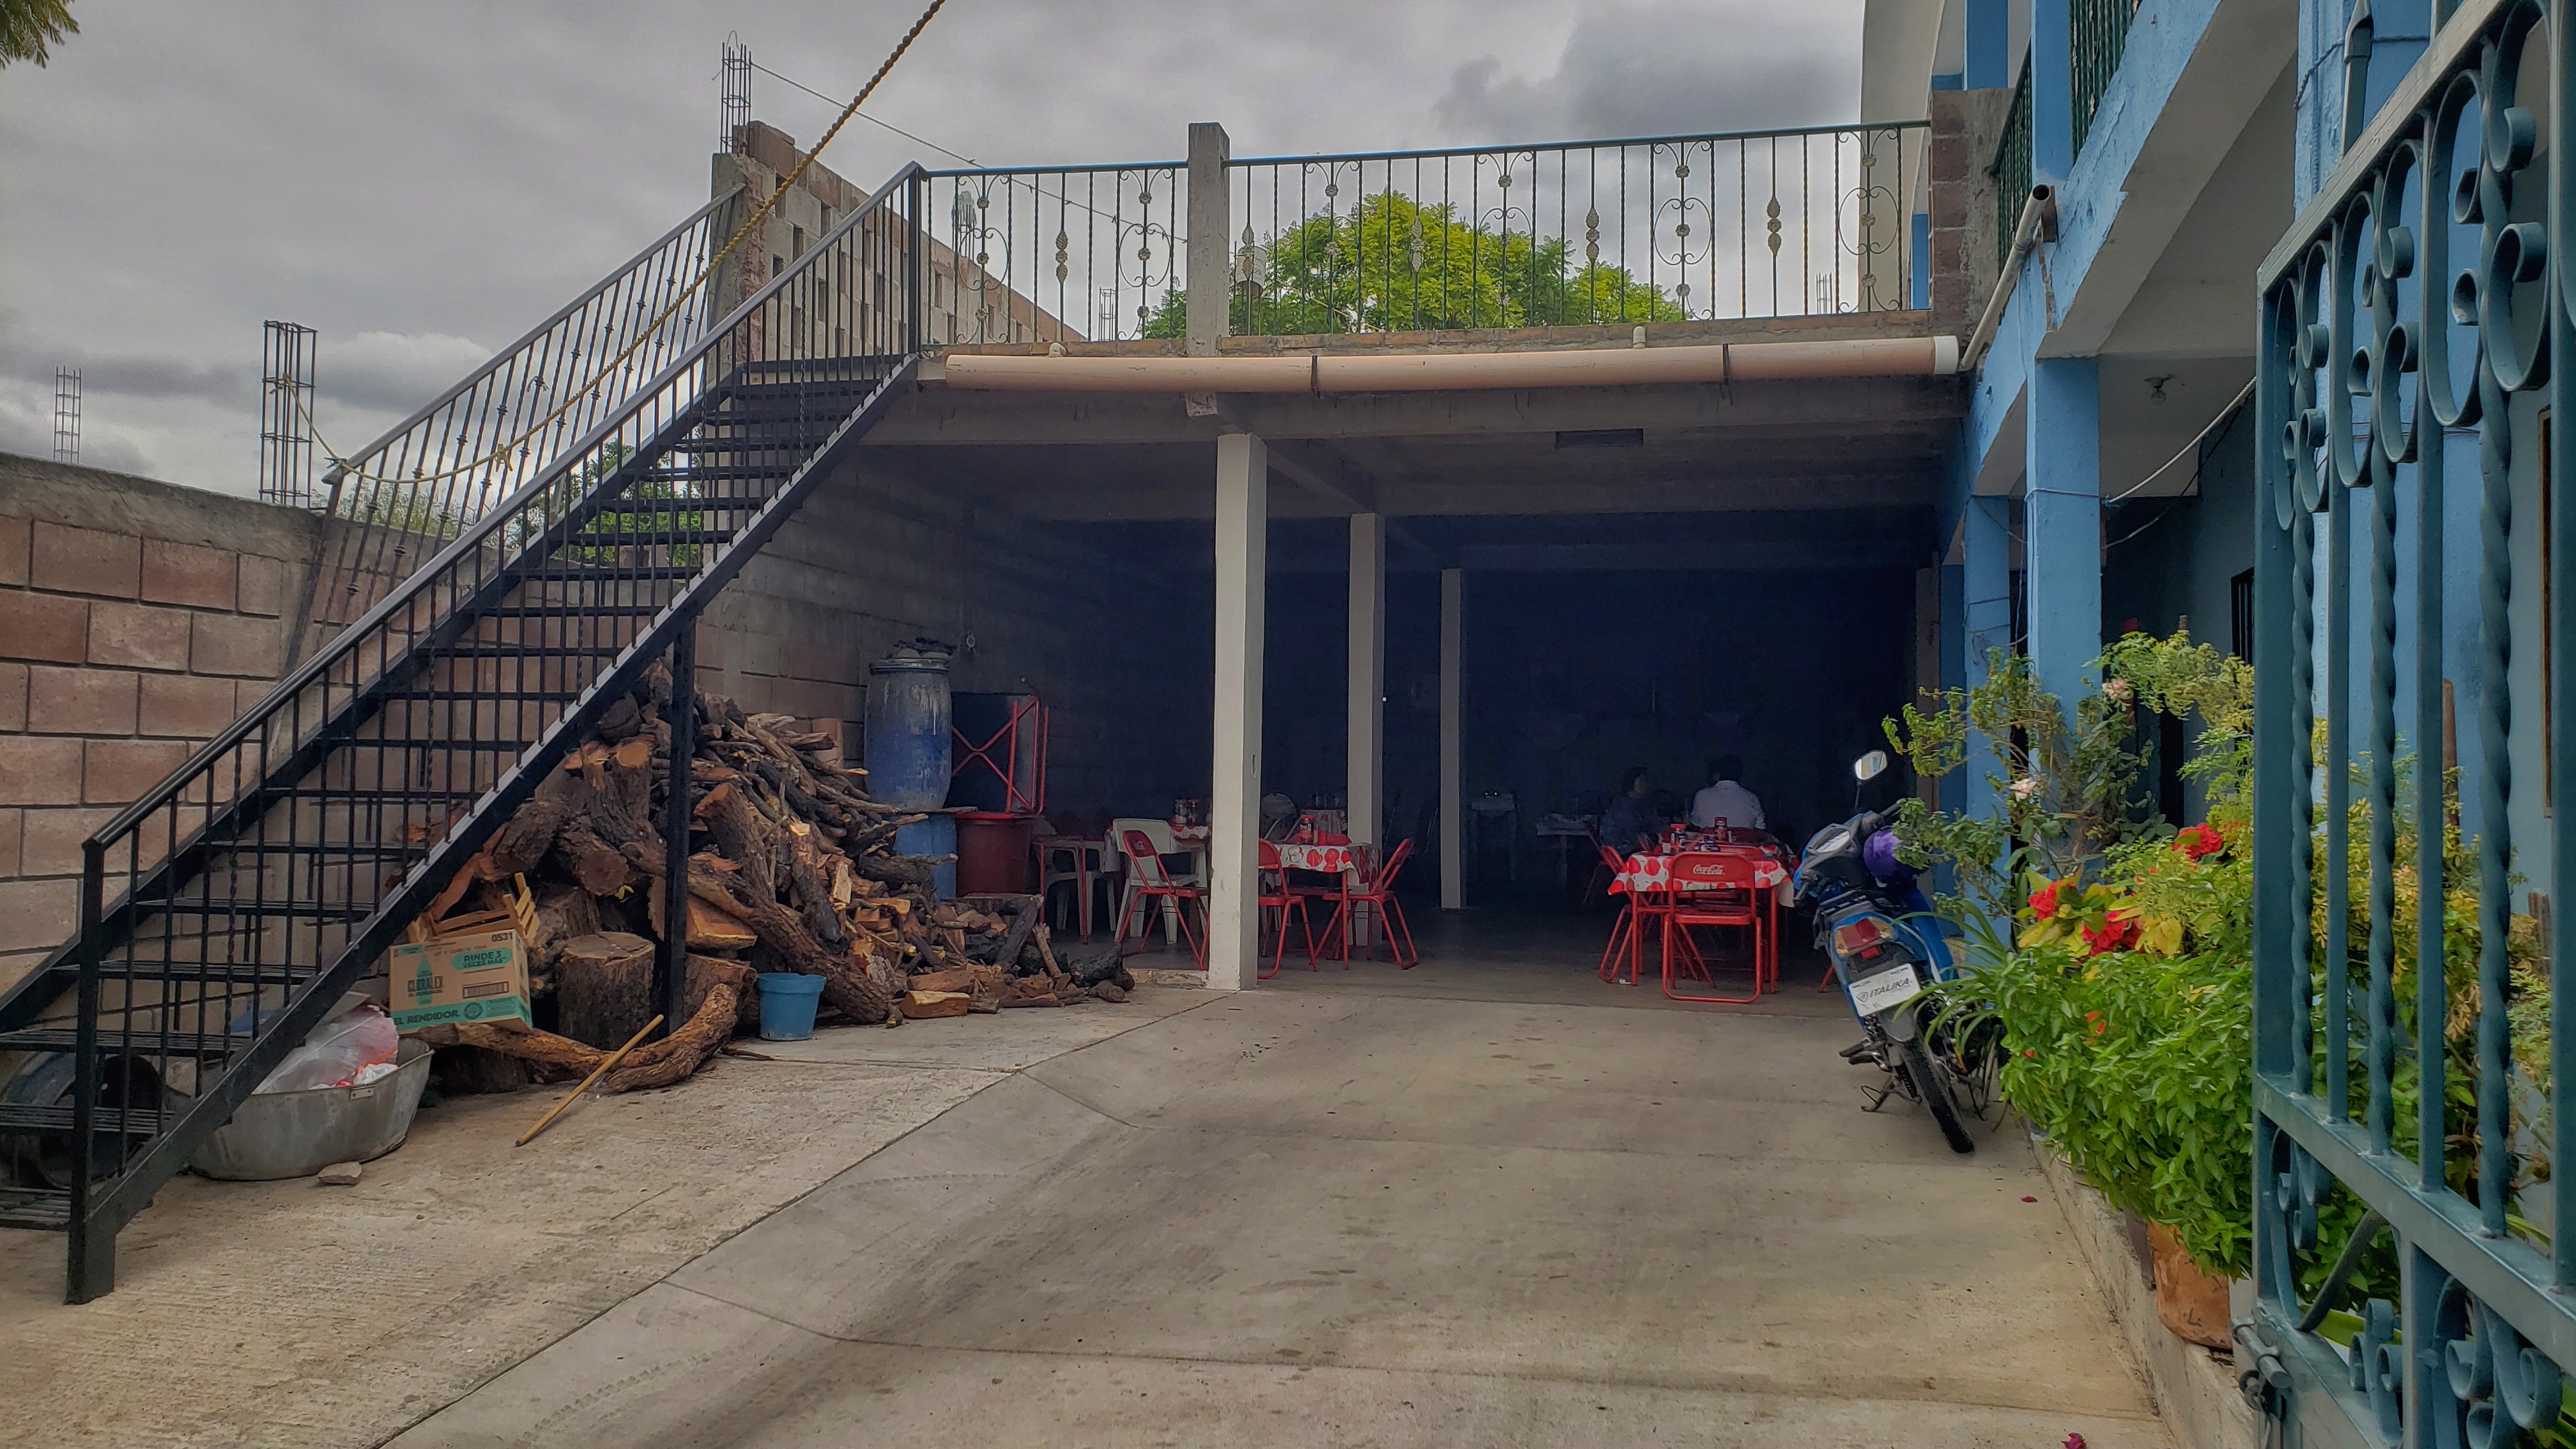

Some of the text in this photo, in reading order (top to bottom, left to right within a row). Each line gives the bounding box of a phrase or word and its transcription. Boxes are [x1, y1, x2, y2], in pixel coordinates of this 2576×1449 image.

[464, 952, 493, 962] RINDE
[1869, 977, 1910, 998] ITALIKA
[394, 1017, 404, 1025] EL
